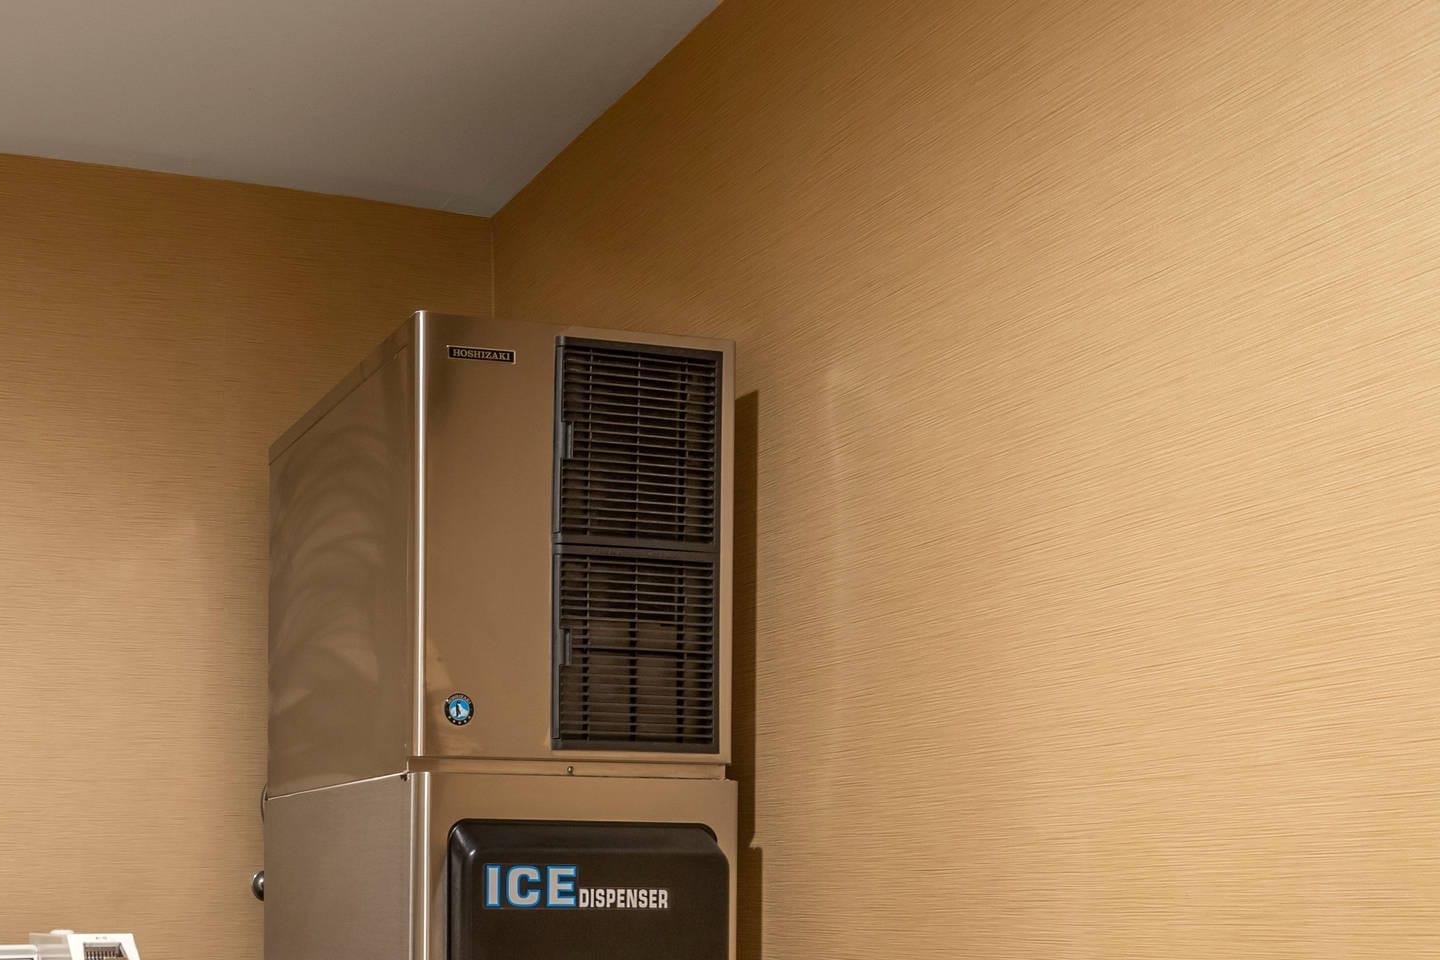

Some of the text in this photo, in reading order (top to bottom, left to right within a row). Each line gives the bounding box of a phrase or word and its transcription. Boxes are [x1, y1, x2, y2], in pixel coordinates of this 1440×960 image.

[452, 349, 511, 361] HOSHIZAKI
[485, 864, 668, 909] ICE DISPENSER
